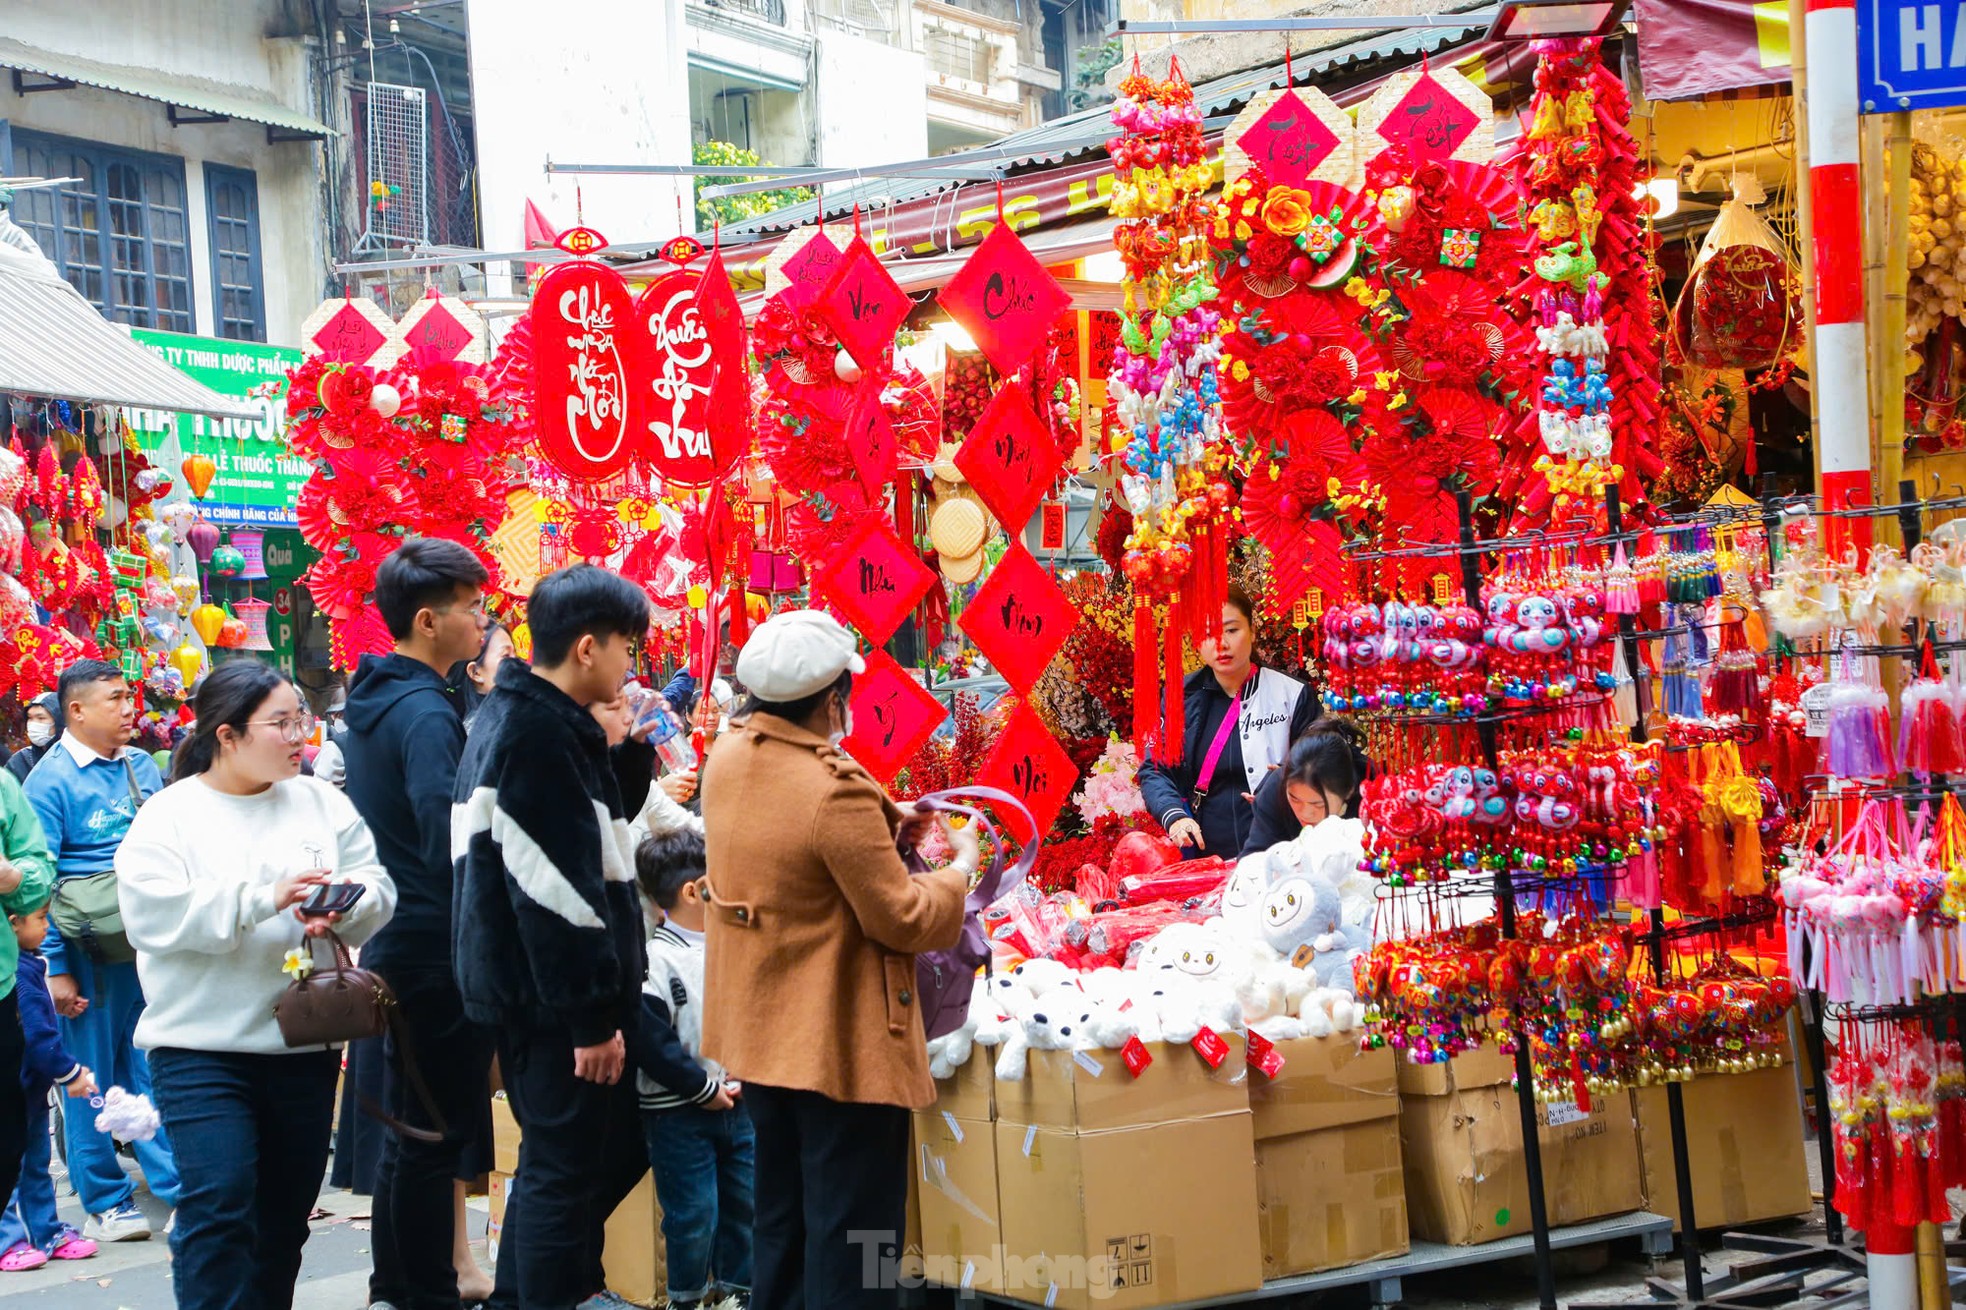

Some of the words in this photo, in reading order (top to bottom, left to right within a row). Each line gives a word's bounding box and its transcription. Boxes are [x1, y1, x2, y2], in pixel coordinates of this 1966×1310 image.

[166, 346, 183, 365] TY
[185, 349, 220, 371] TNHH
[222, 352, 255, 375] DƯỢC
[213, 448, 229, 471] LẺ
[231, 451, 274, 474] THUỐC
[213, 505, 240, 520] CHÍNH
[277, 592, 292, 609] 34
